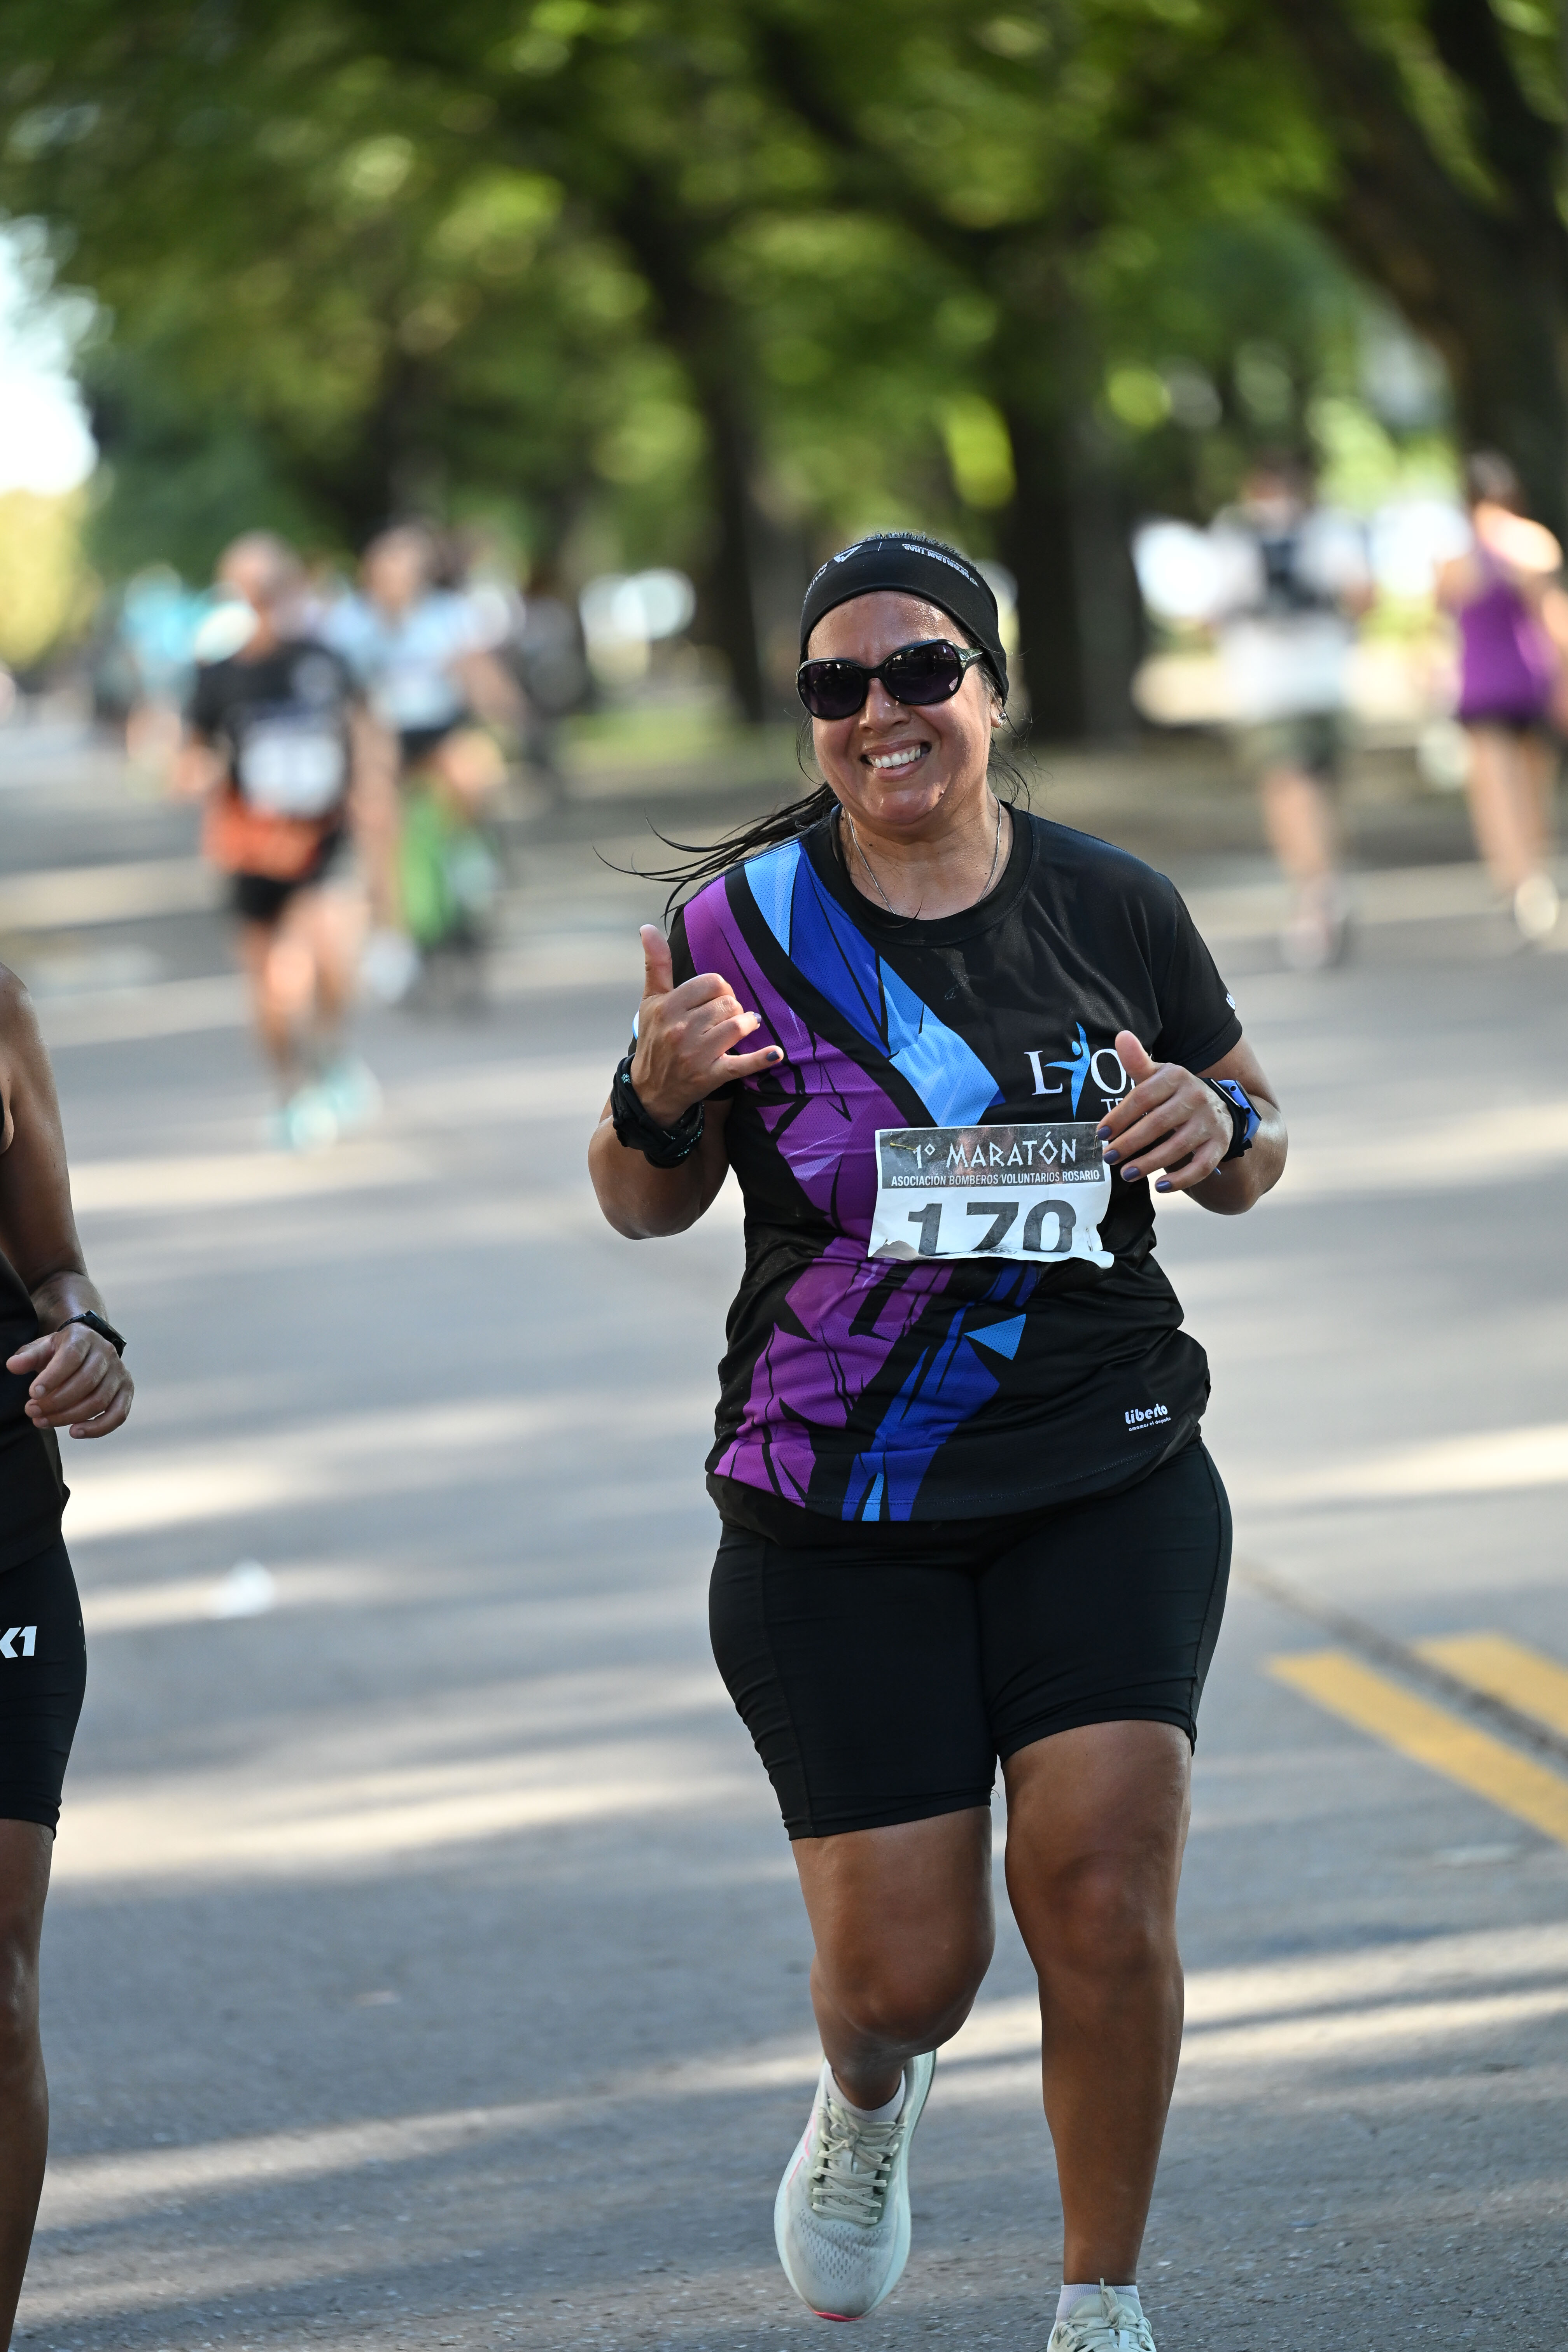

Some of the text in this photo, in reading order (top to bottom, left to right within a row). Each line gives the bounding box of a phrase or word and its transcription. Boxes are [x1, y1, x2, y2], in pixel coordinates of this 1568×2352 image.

[946, 1131, 1076, 1167] MARATÓN
[891, 1169, 1100, 1186] ASOCIACIÓN BOMBEROS VOLUNTARIOS ROSARIO
[908, 1199, 1077, 1255] 170
